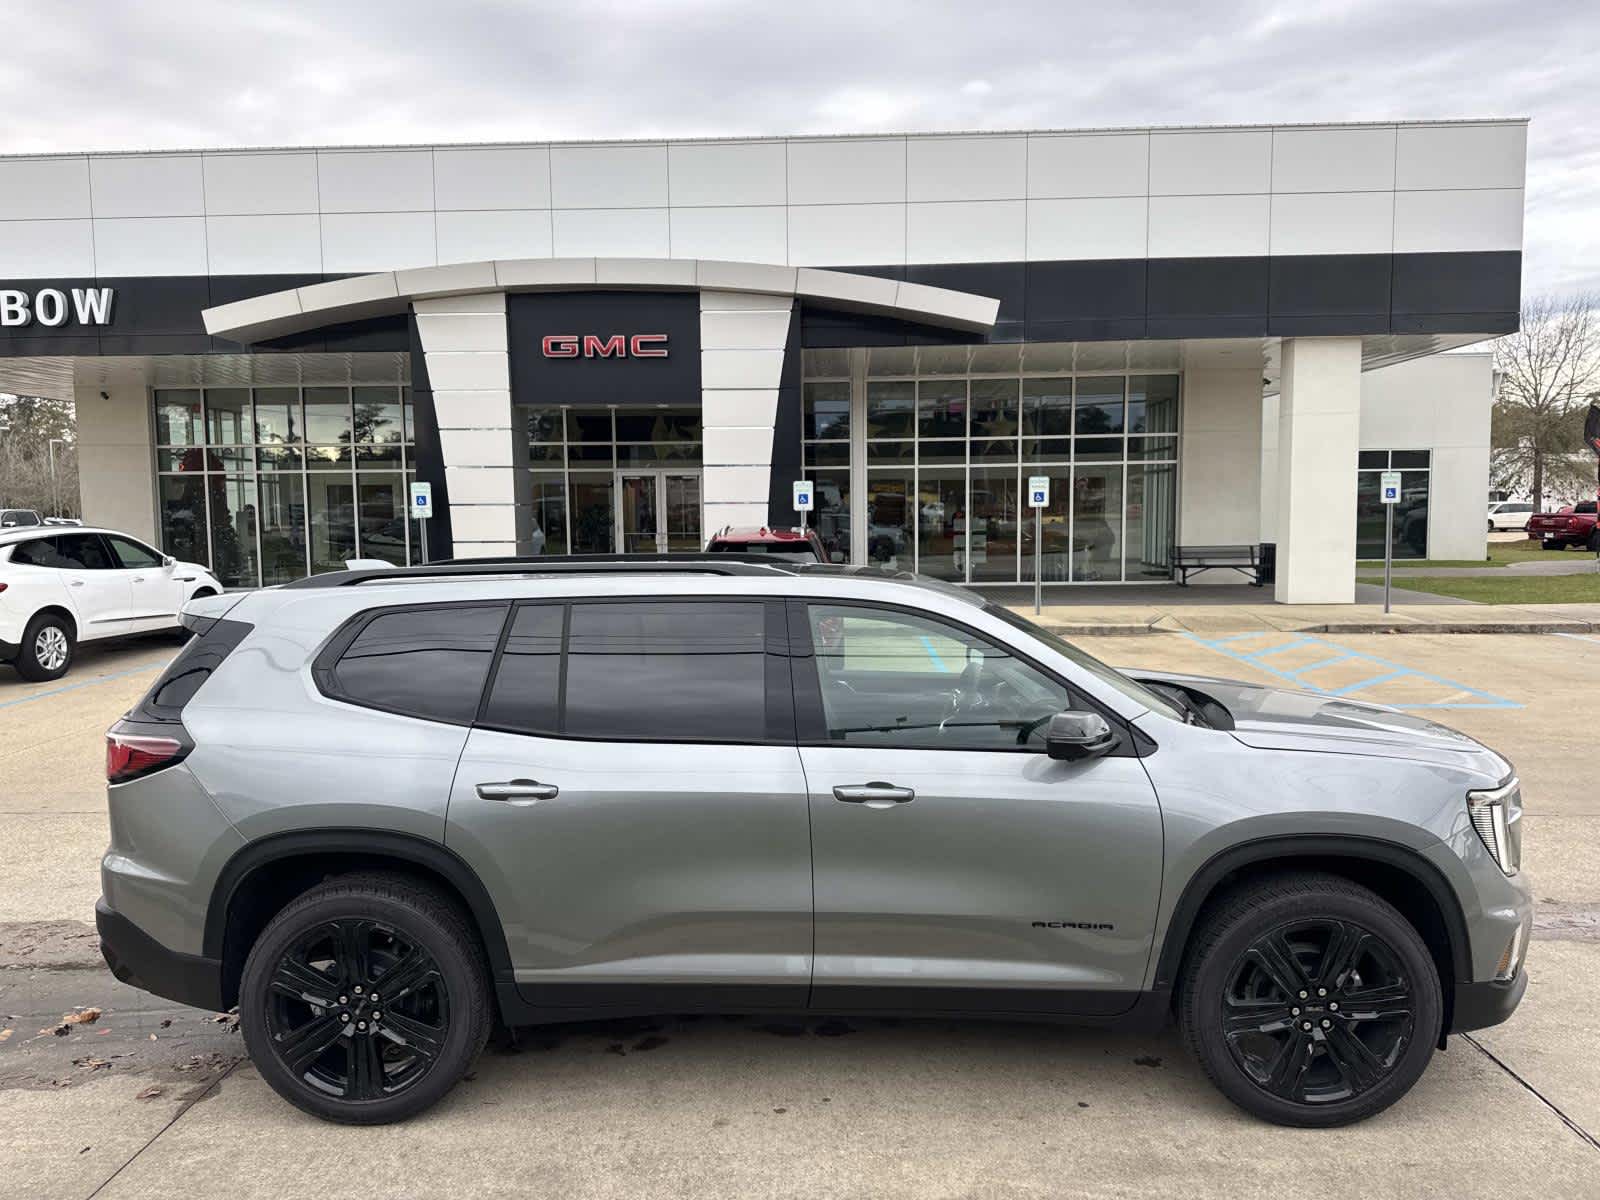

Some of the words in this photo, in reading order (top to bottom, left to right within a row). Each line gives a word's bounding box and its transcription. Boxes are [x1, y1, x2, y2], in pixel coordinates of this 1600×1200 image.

[0, 288, 113, 327] BOW
[542, 334, 668, 358] GMC
[1032, 922, 1114, 930] ACADIA
